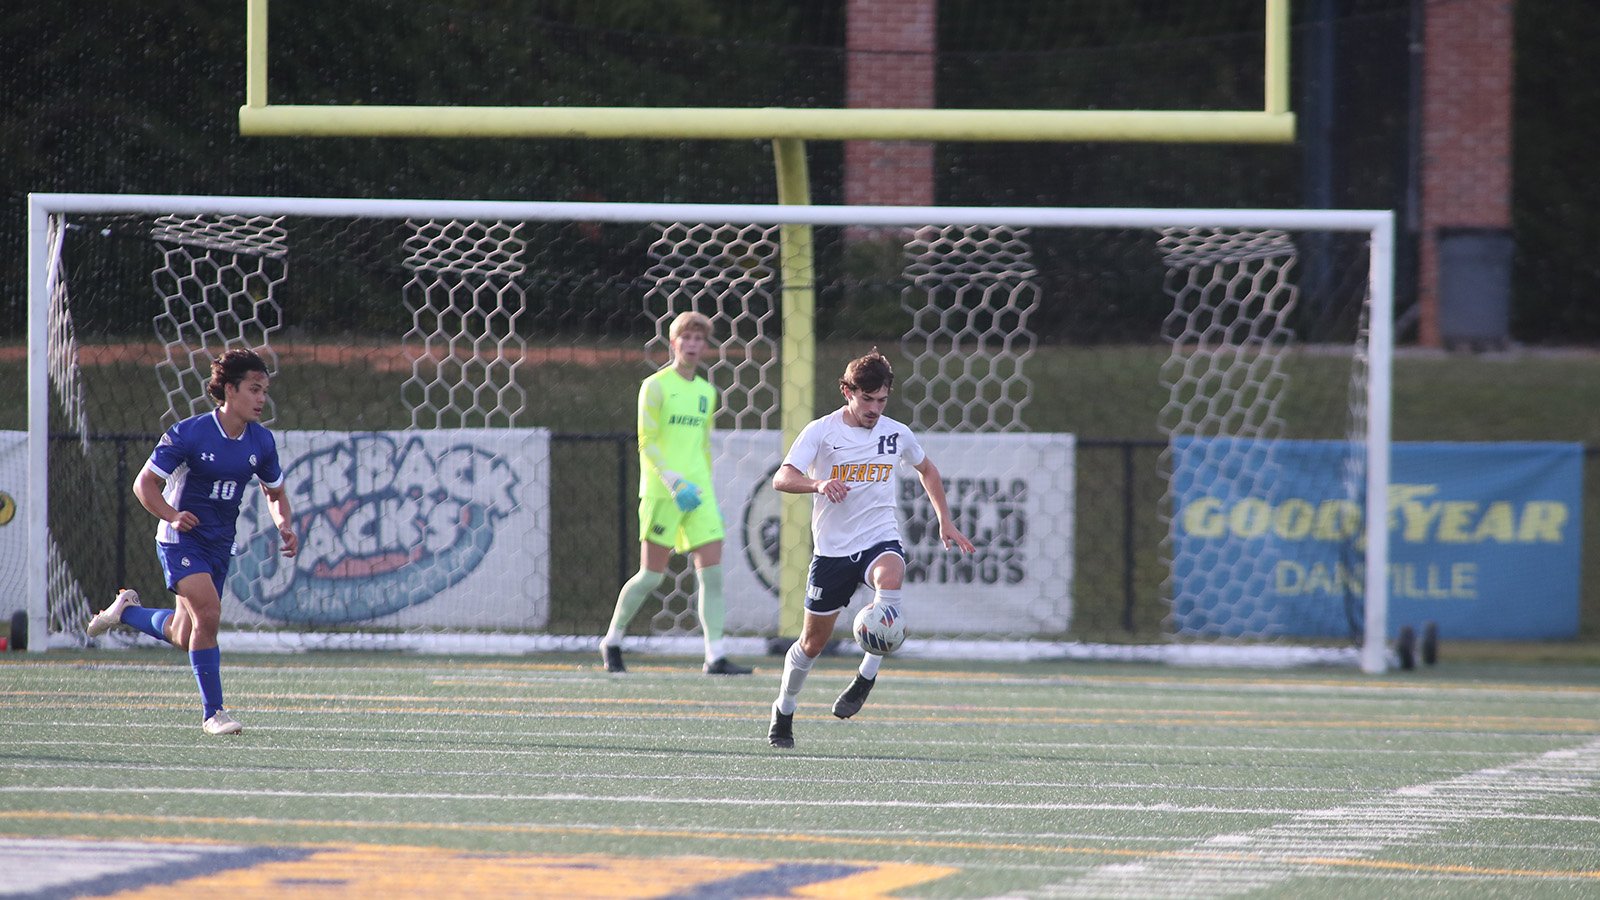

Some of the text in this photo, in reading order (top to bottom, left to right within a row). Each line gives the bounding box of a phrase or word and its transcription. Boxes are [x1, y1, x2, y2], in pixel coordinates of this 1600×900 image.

[877, 432, 899, 455] 19
[830, 463, 893, 482] AVERETT
[208, 480, 237, 500] 10
[1275, 560, 1479, 600] DANILLE
